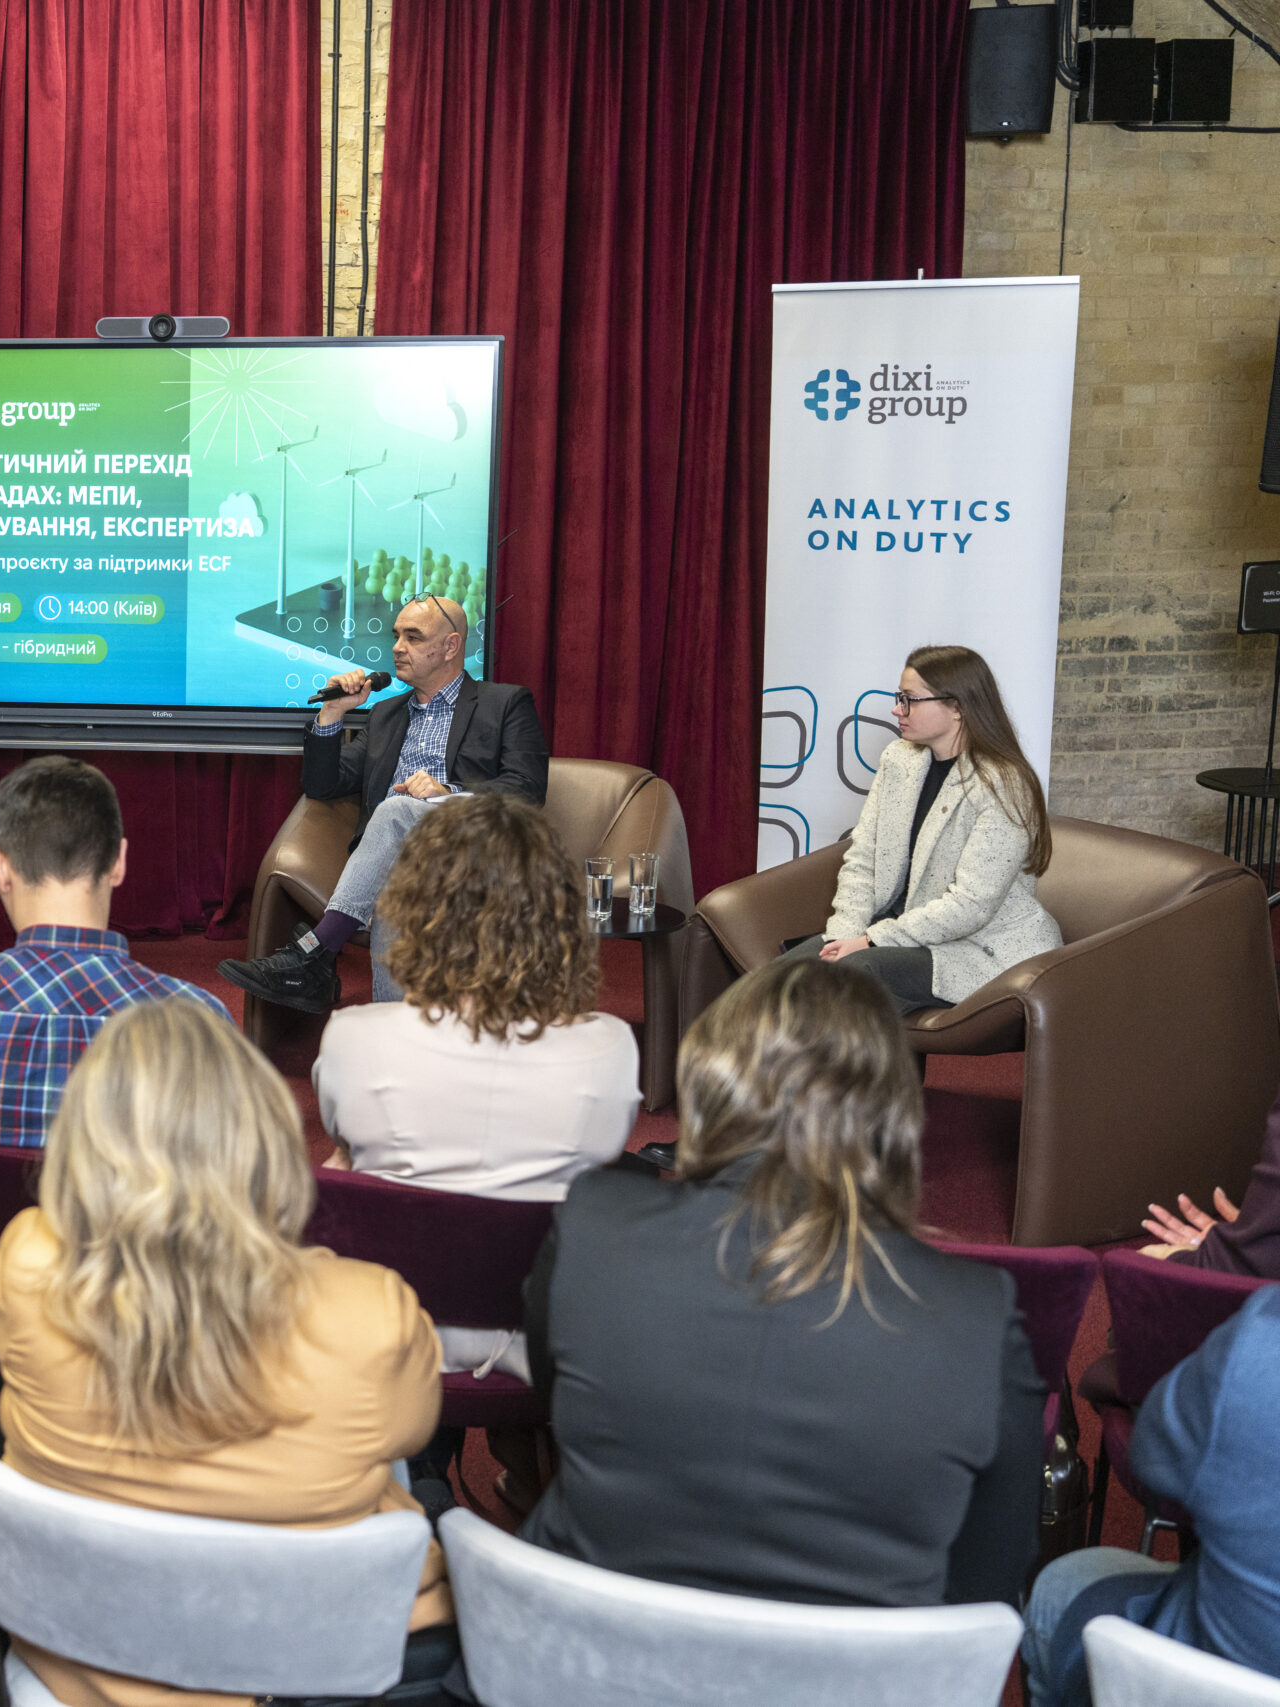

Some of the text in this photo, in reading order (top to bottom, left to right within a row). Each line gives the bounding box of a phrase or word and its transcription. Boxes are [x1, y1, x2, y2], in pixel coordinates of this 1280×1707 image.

[869, 363, 933, 391] dixi
[867, 397, 968, 424] group
[94, 453, 193, 477] ПЕРЕХІД
[68, 485, 143, 509] МЕПИ,
[807, 498, 1011, 522] ANALYTICS
[103, 516, 256, 538] ЕКСПЕРТИЗА
[807, 529, 973, 554] ON DUTY
[73, 558, 93, 570] за
[98, 555, 193, 574] підтримки
[199, 556, 232, 571] ECF
[68, 600, 157, 618] 14:00 (Київ)
[14, 640, 97, 657] гібридний
